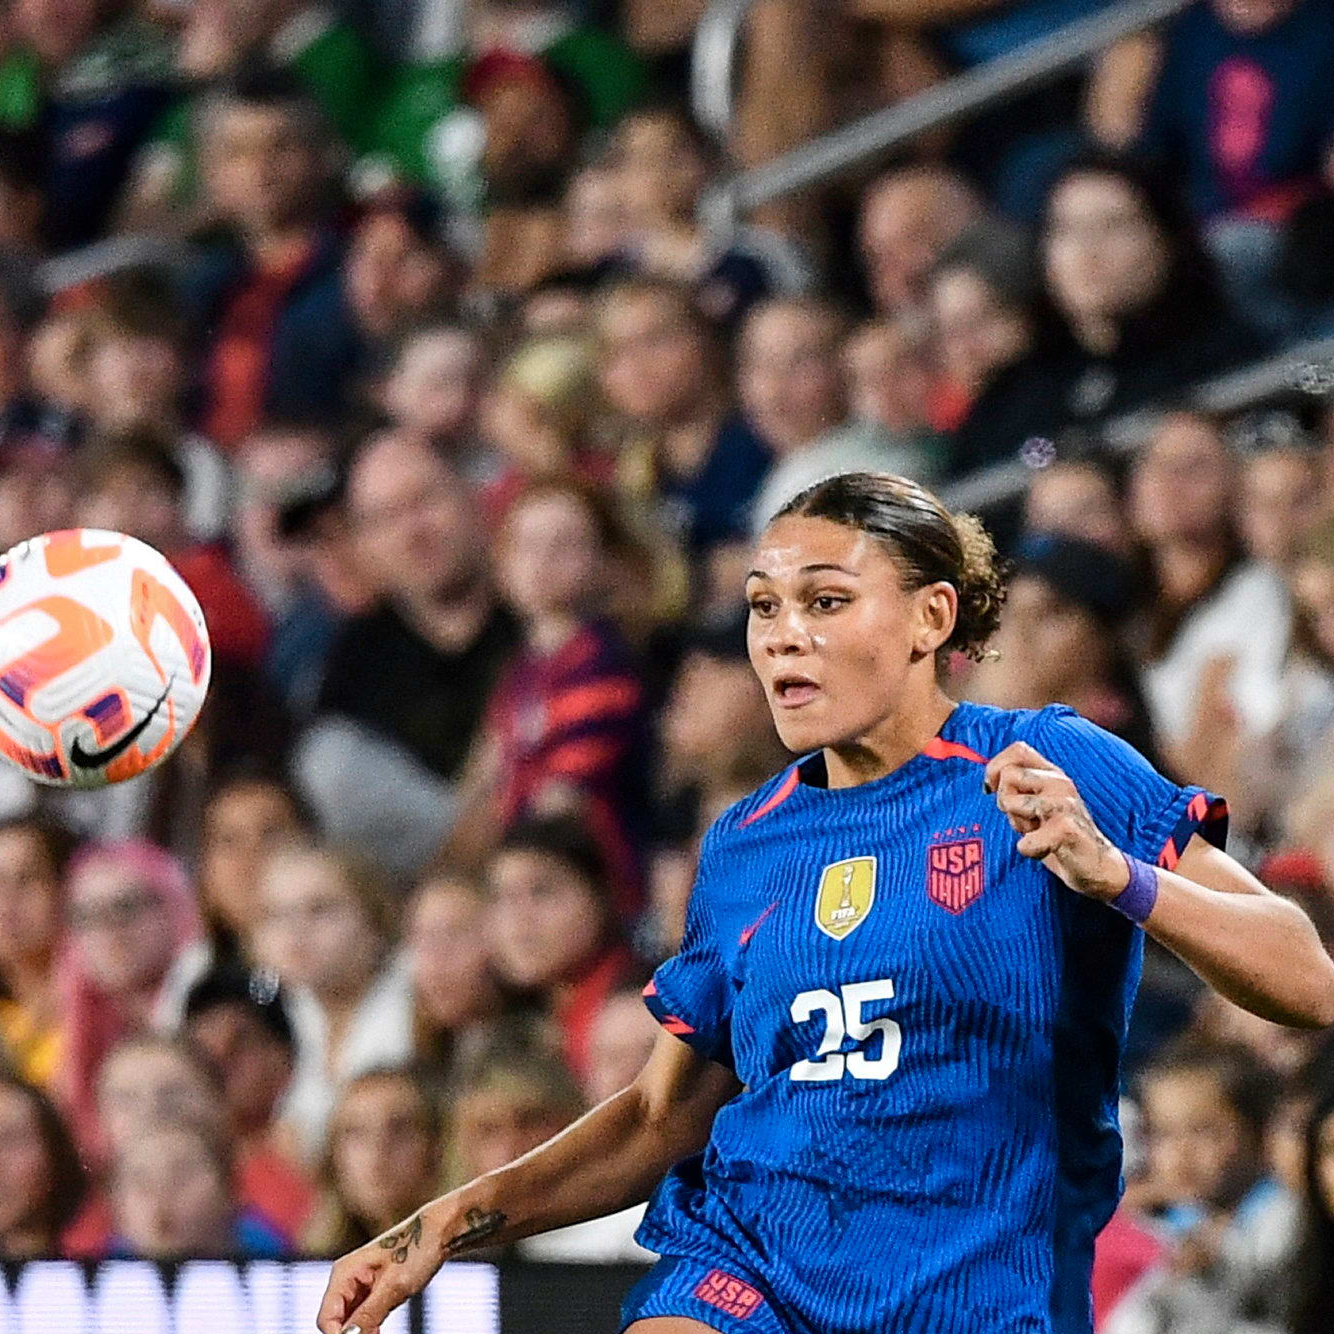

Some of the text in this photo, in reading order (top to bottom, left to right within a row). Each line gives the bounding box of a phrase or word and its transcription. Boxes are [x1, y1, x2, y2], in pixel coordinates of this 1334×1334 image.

[932, 843, 981, 875] USA
[789, 978, 902, 1081] 25
[708, 1272, 758, 1307] USA
